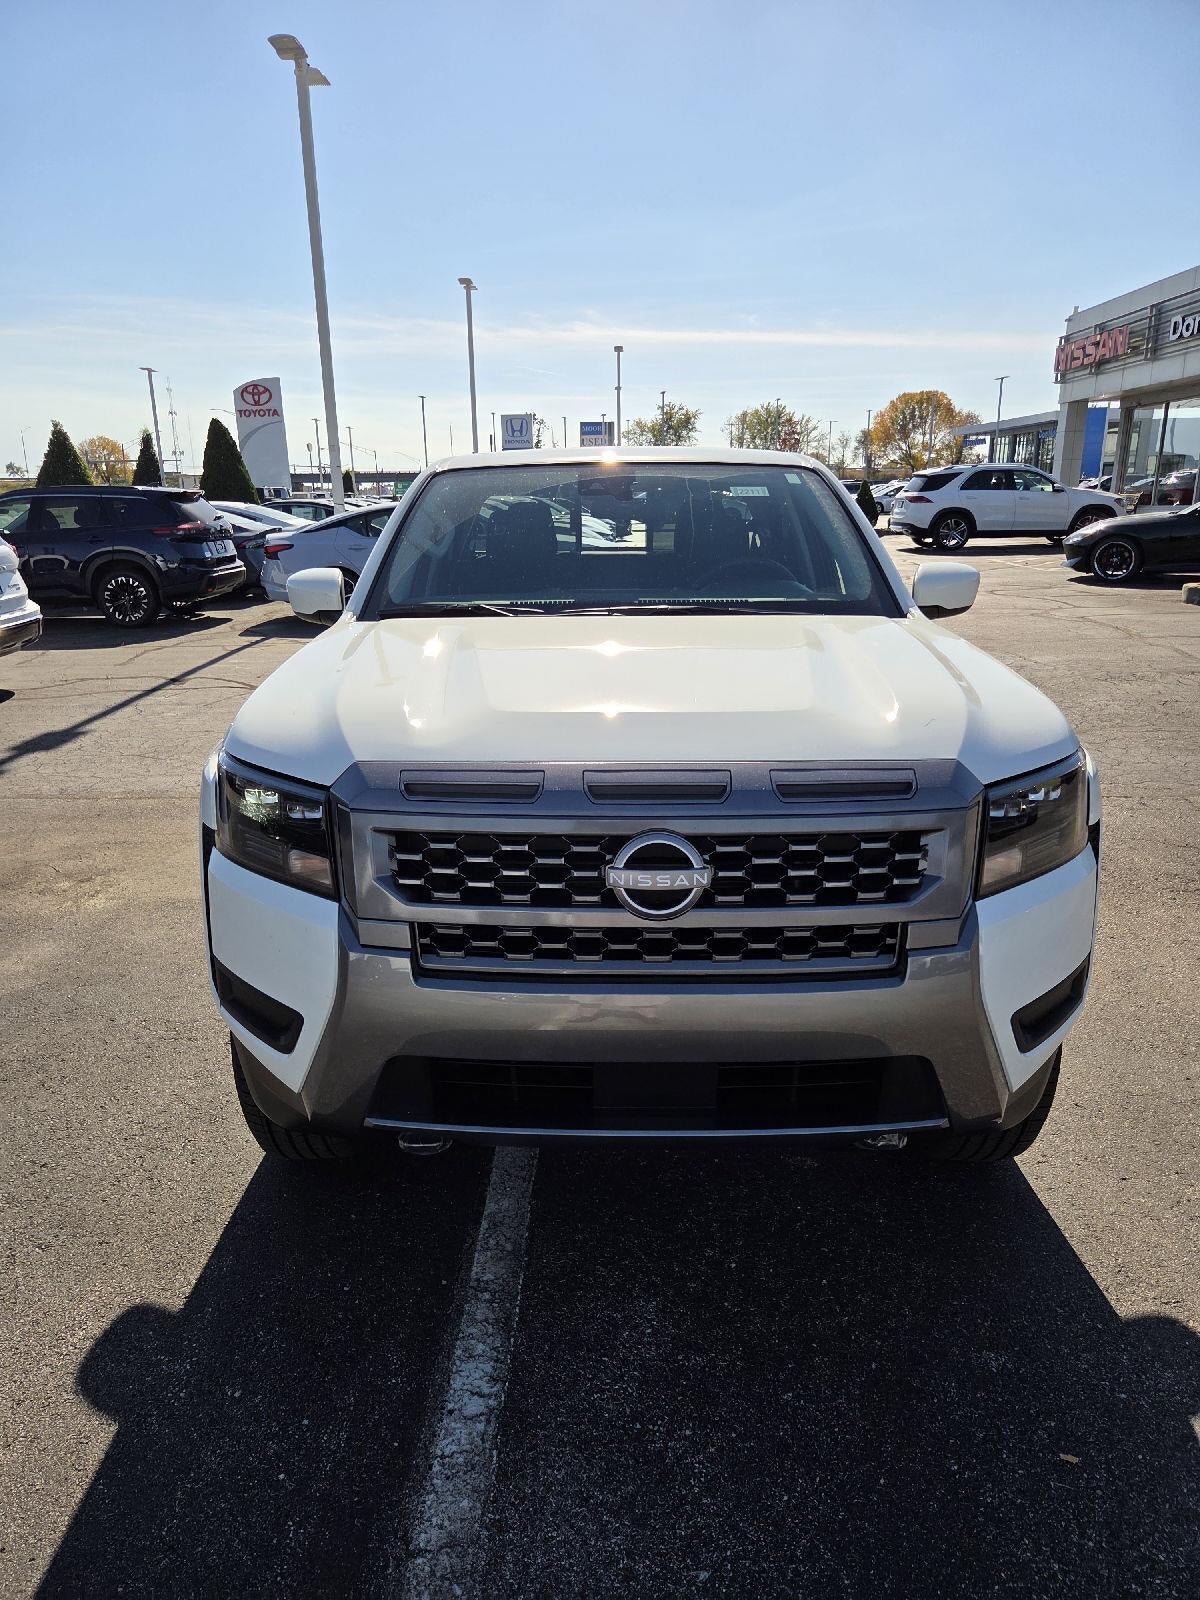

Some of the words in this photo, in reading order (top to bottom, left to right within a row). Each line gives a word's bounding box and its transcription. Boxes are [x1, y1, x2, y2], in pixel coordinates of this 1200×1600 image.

[1054, 325, 1129, 373] NISSAN
[237, 408, 280, 418] TOYOTA
[581, 437, 607, 446] USED
[609, 872, 708, 887] NISSAN
